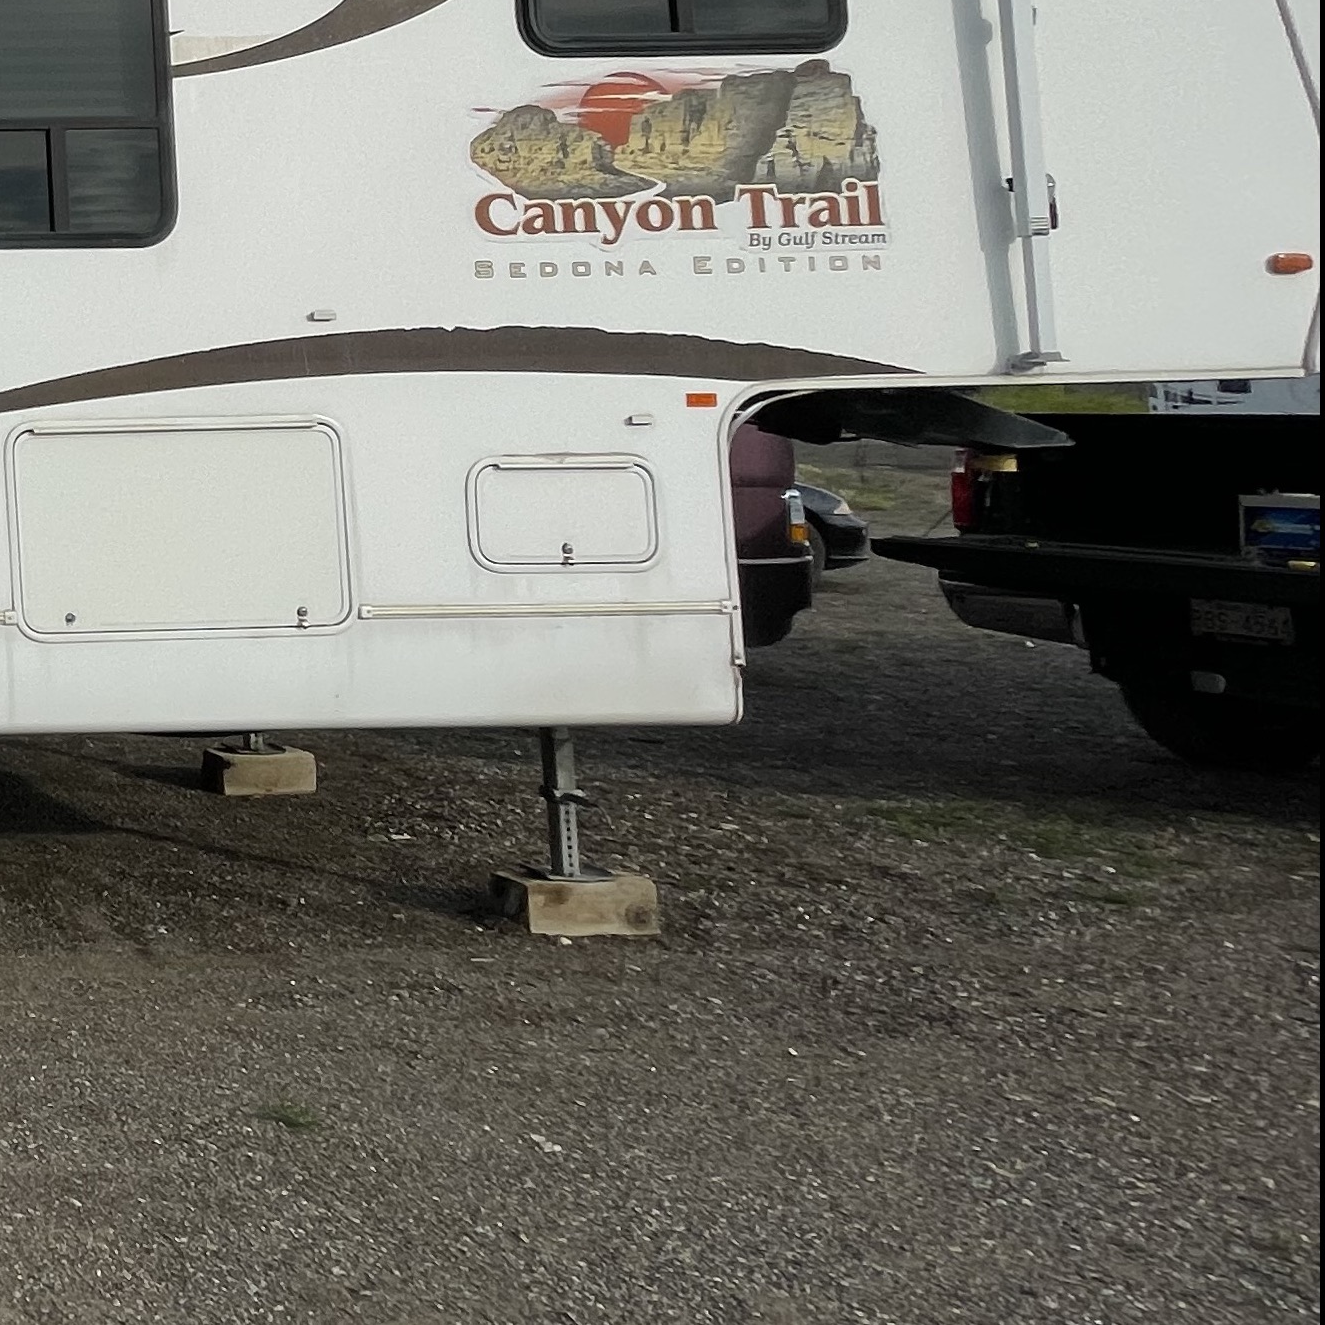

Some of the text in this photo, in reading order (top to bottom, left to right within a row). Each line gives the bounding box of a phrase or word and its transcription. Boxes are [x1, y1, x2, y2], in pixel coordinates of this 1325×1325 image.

[474, 180, 886, 246] Canyon Trail
[748, 231, 887, 251] By Gulf Stream
[473, 253, 882, 279] SEDONA EDITION
